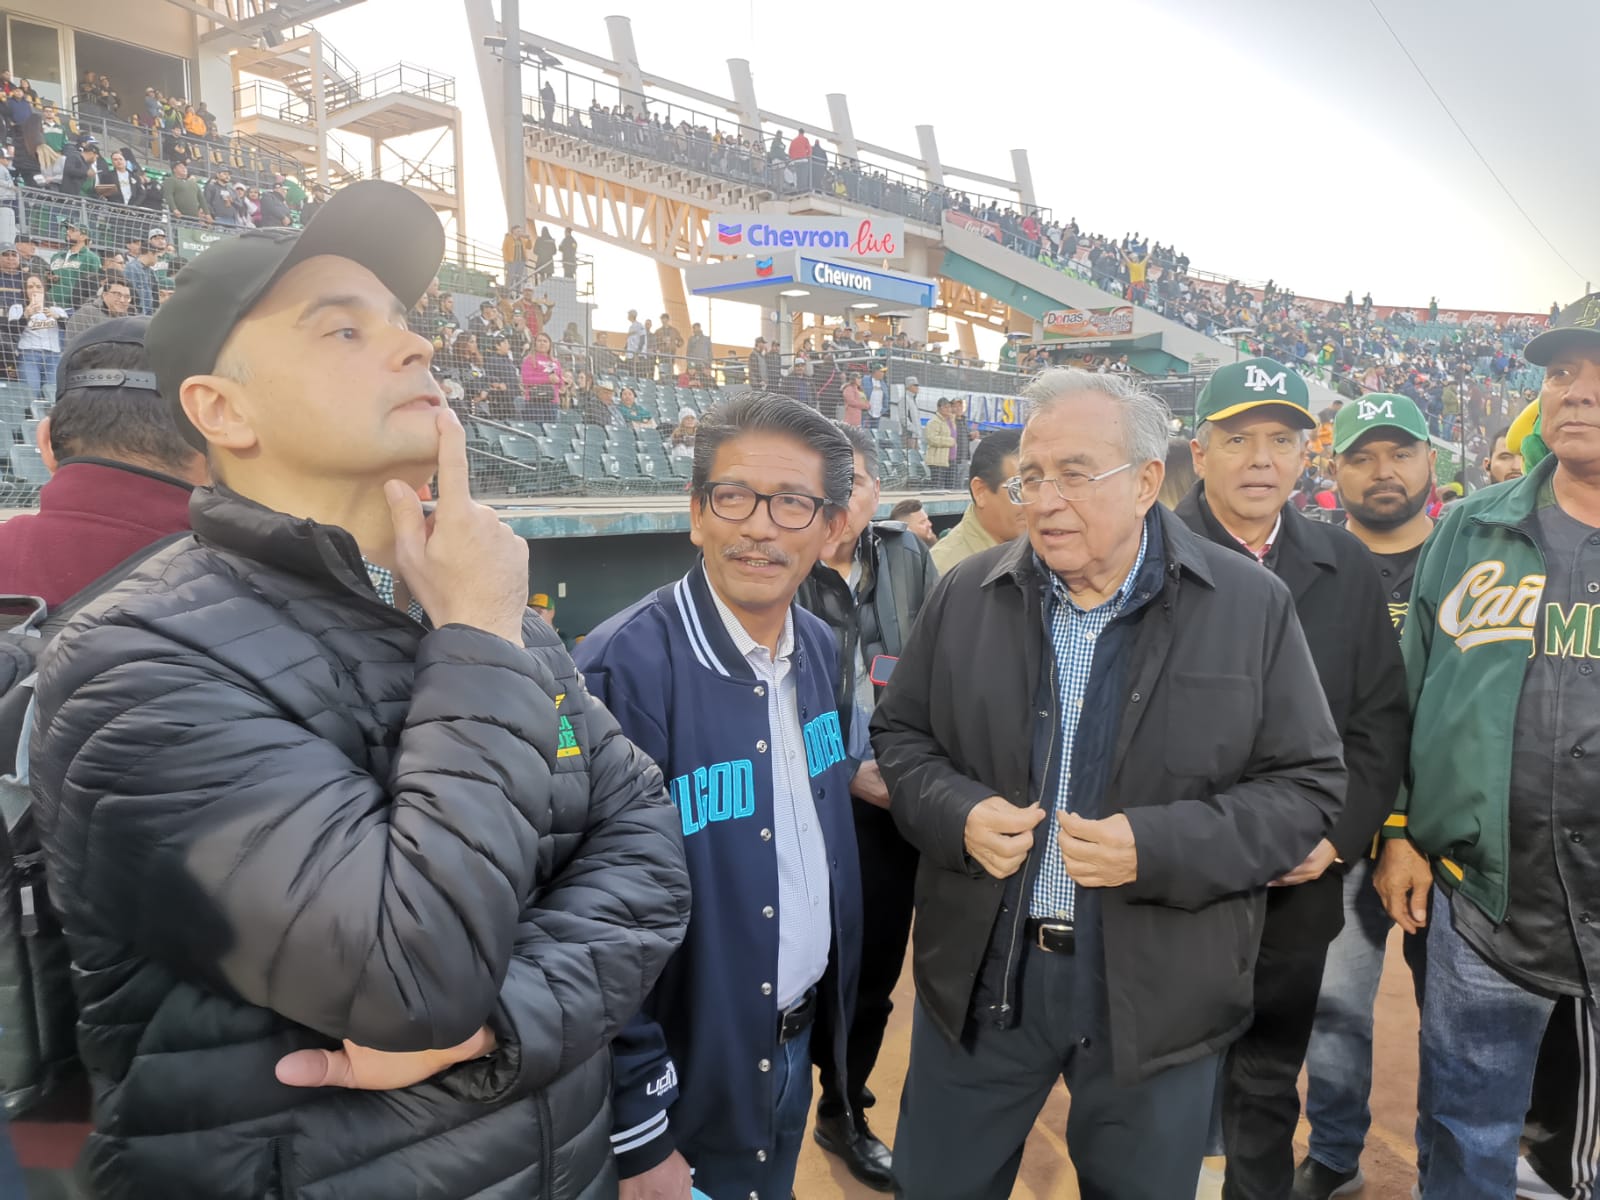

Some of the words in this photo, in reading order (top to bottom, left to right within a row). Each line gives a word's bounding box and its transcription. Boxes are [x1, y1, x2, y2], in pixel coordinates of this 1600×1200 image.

[747, 224, 849, 248] Chevron
[850, 219, 896, 255] live
[814, 263, 872, 291] Chevron
[1047, 312, 1083, 325] Donas
[1244, 365, 1287, 395] LM
[1357, 400, 1396, 420] LM
